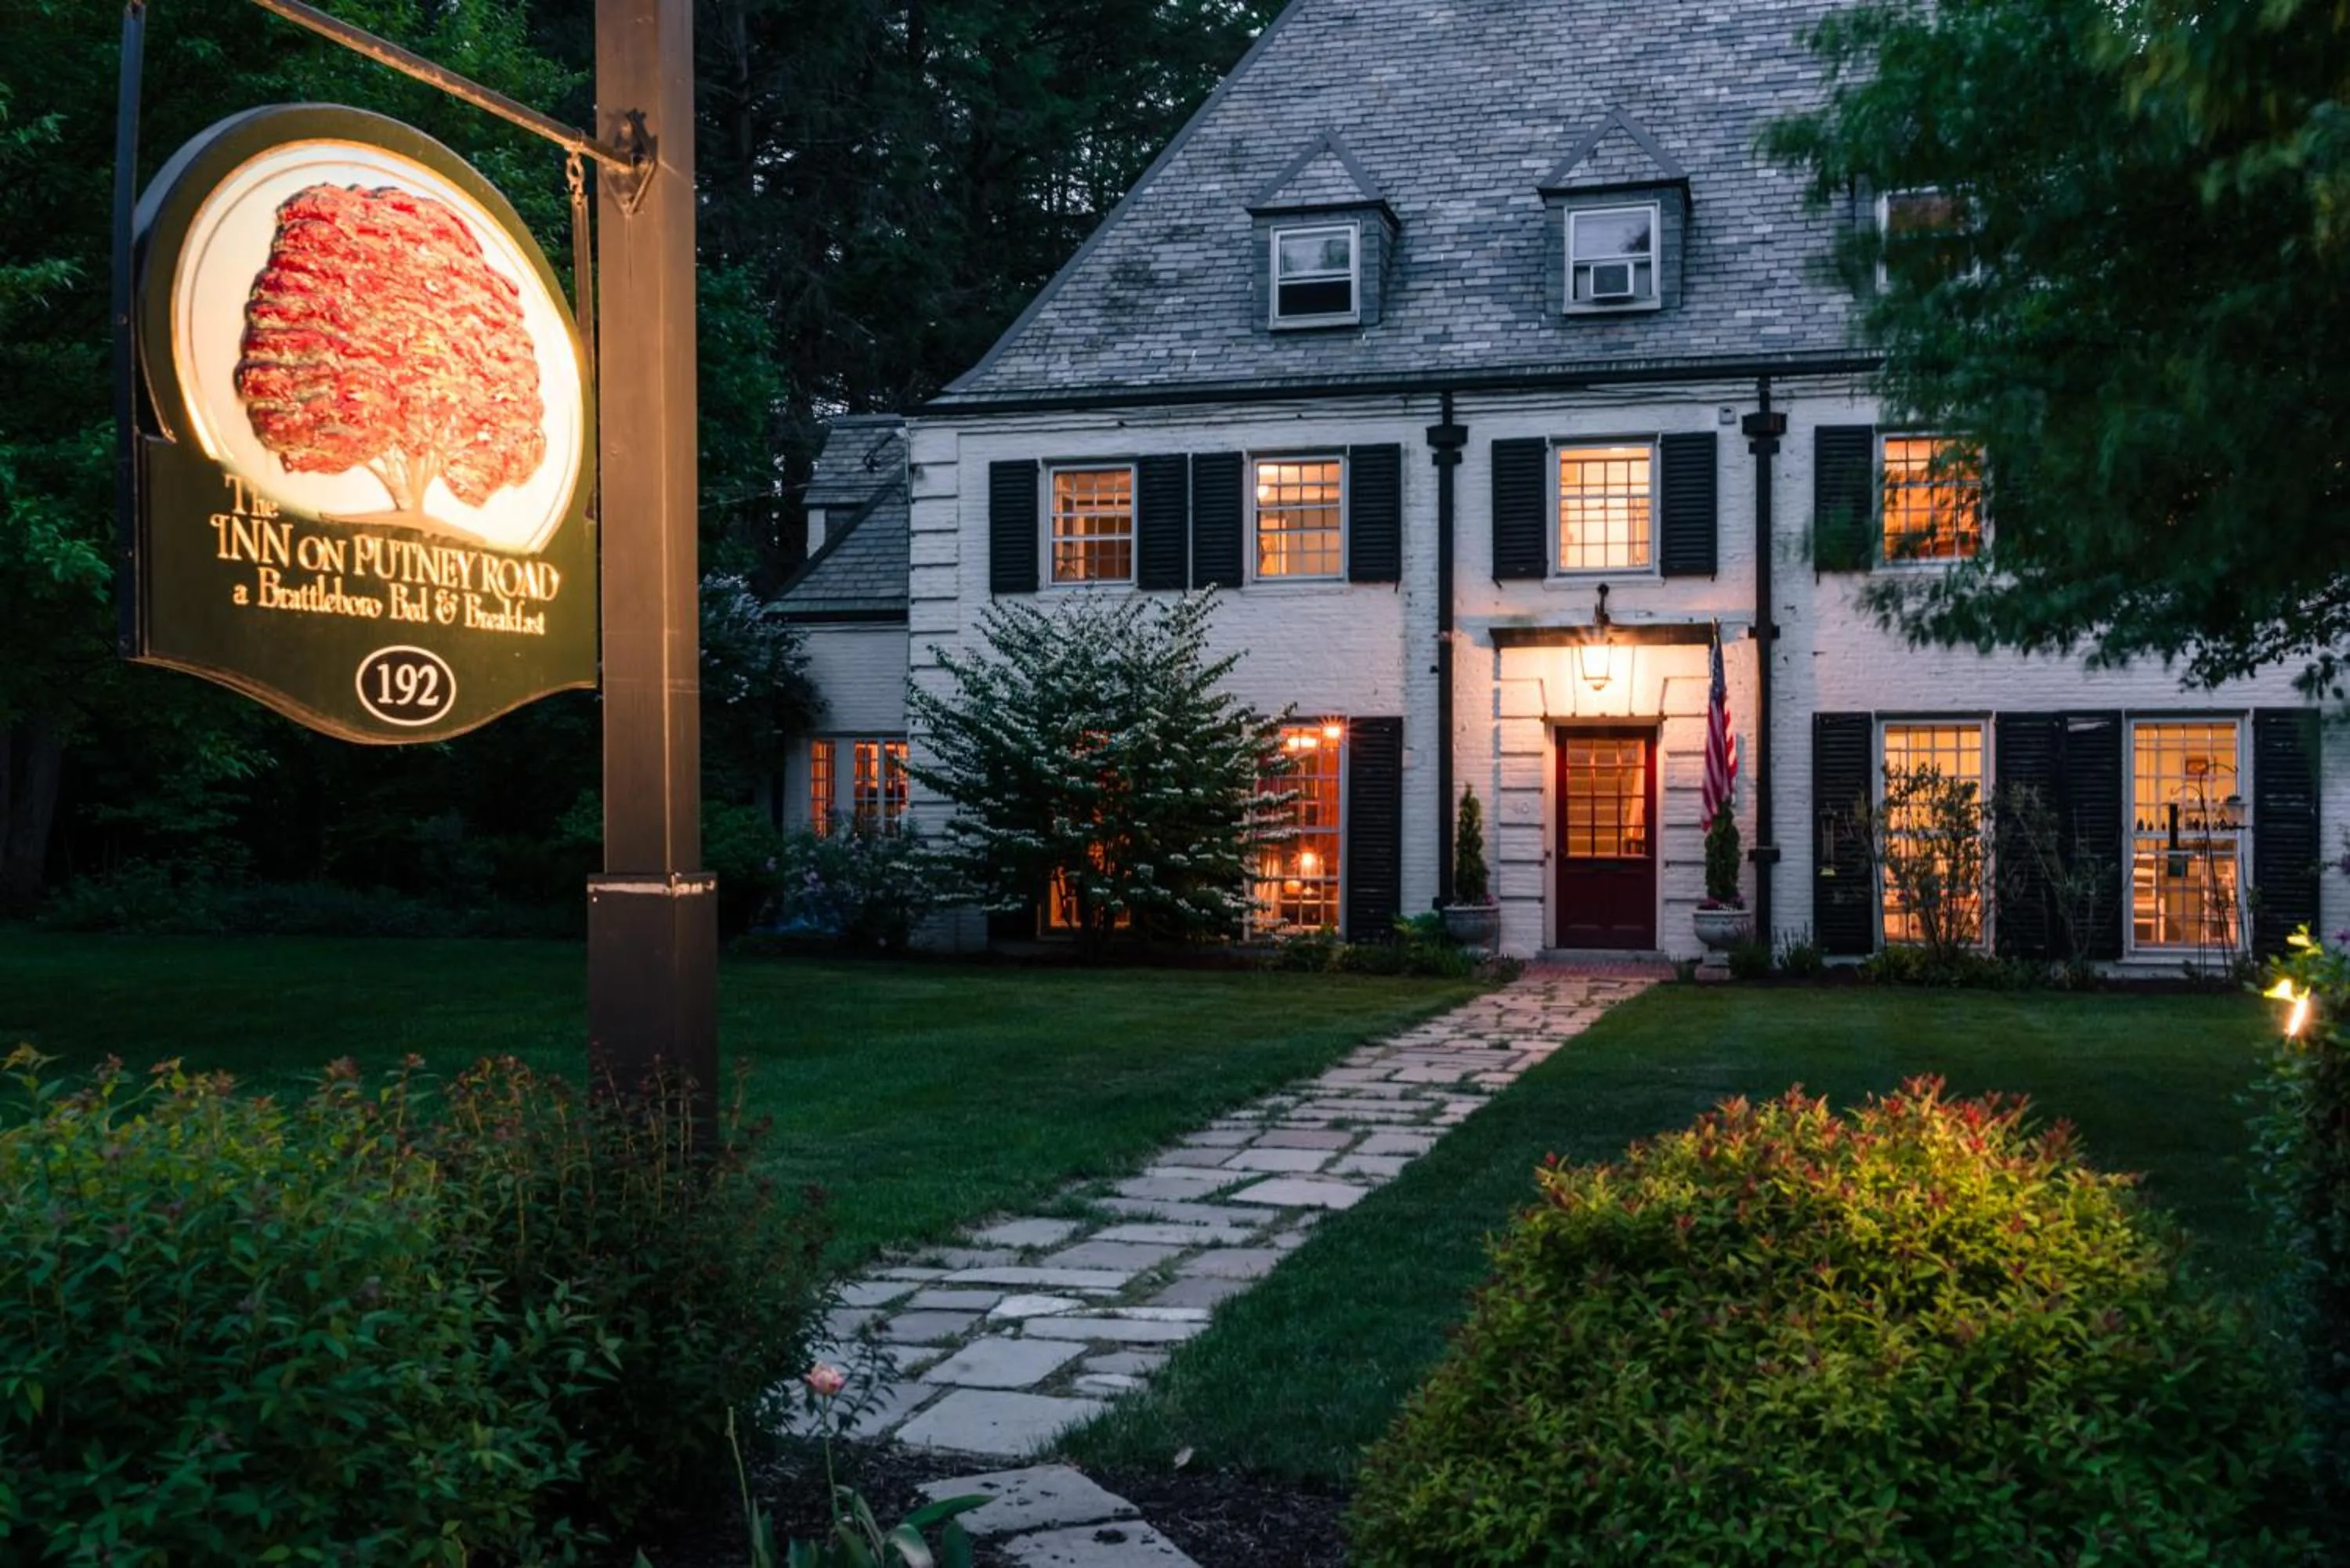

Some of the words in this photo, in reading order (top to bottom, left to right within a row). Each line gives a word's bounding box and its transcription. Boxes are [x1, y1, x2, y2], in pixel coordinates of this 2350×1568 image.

[224, 473, 280, 518] The
[210, 514, 295, 567] INN
[298, 536, 348, 576] ON
[355, 535, 476, 589] PUTNEY
[481, 553, 561, 602] ROAD
[233, 582, 248, 605] a
[257, 566, 383, 619] Brattleboro
[389, 583, 429, 623] Bed
[435, 588, 459, 625] &
[464, 593, 546, 636] Breakfast
[376, 663, 440, 707] 192
